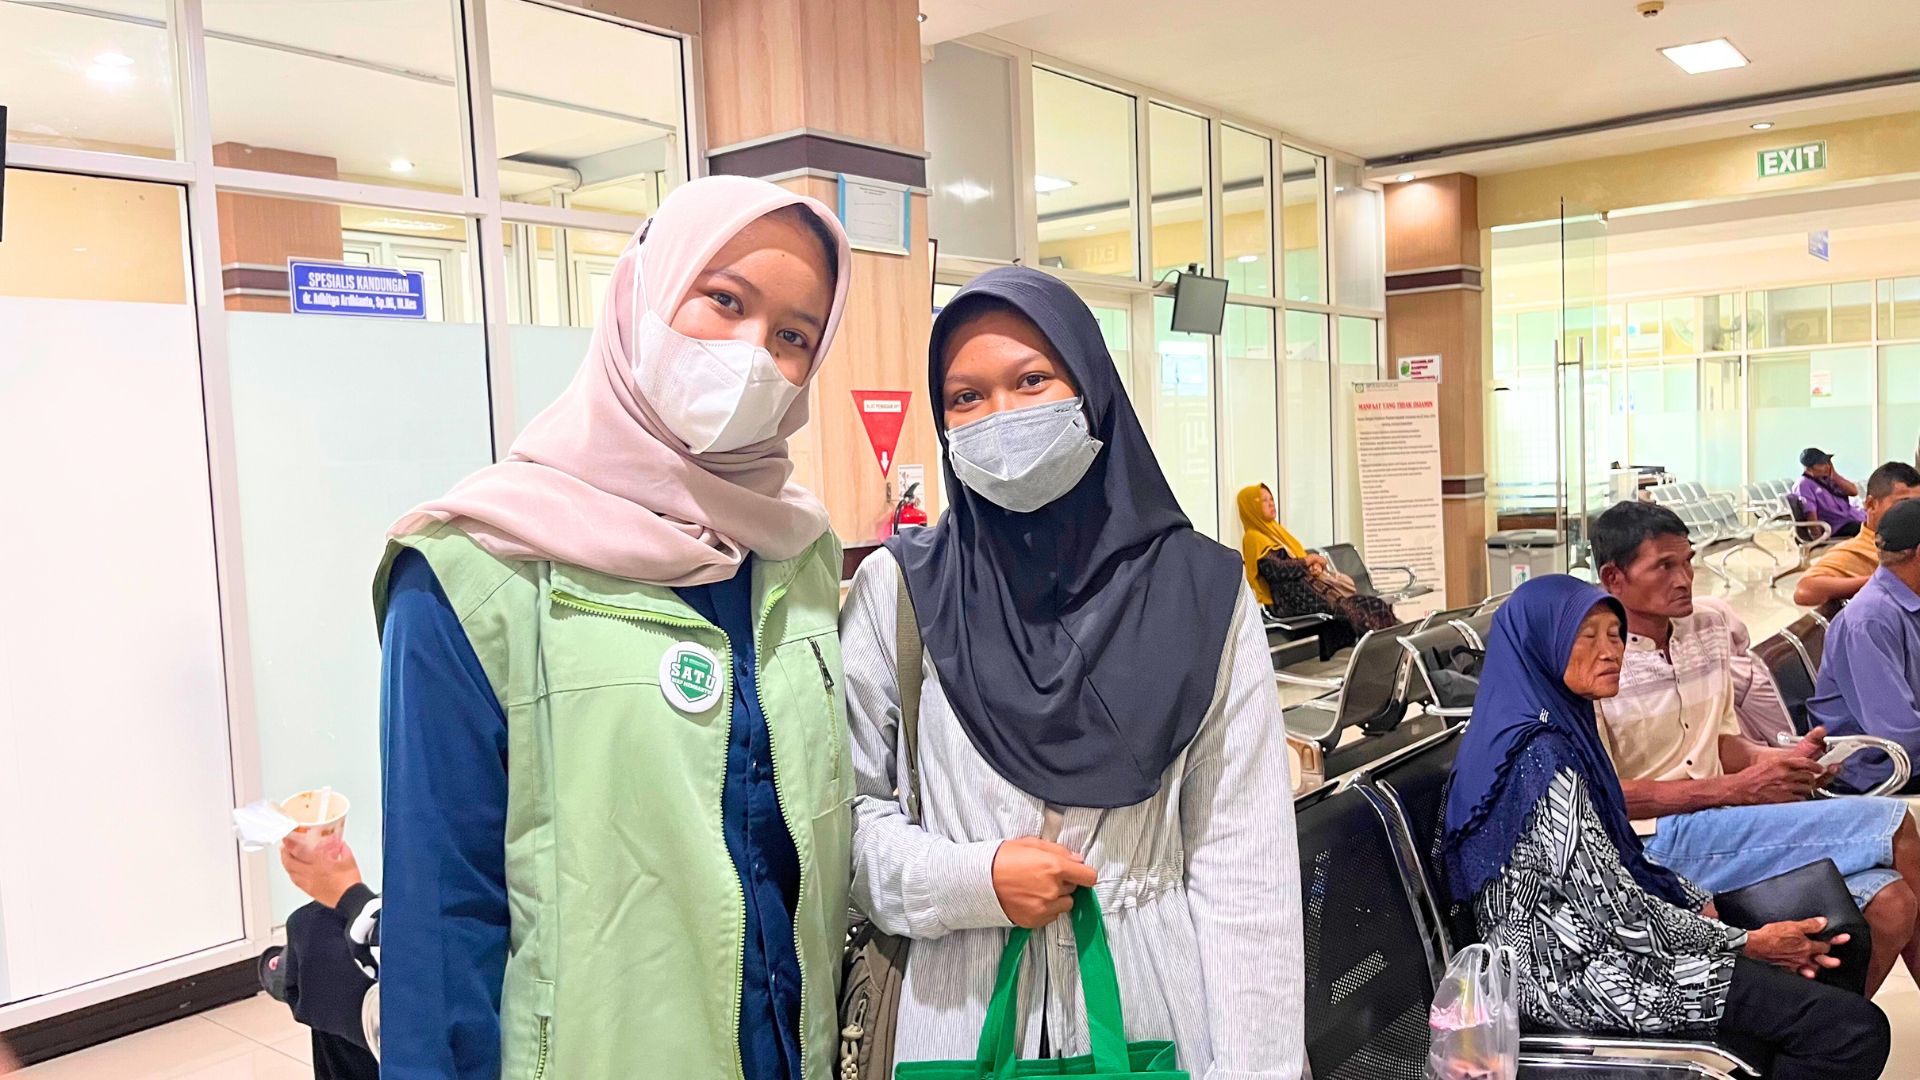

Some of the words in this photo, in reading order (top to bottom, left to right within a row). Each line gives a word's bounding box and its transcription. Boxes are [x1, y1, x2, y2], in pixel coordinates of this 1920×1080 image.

[1763, 144, 1819, 176] EXIT
[308, 271, 355, 290] SPESIALIS
[356, 275, 409, 293] KANDUNGAN
[1358, 402, 1381, 410] MANFAAT
[1397, 401, 1412, 409] TIDAK
[671, 662, 717, 690] SATU
